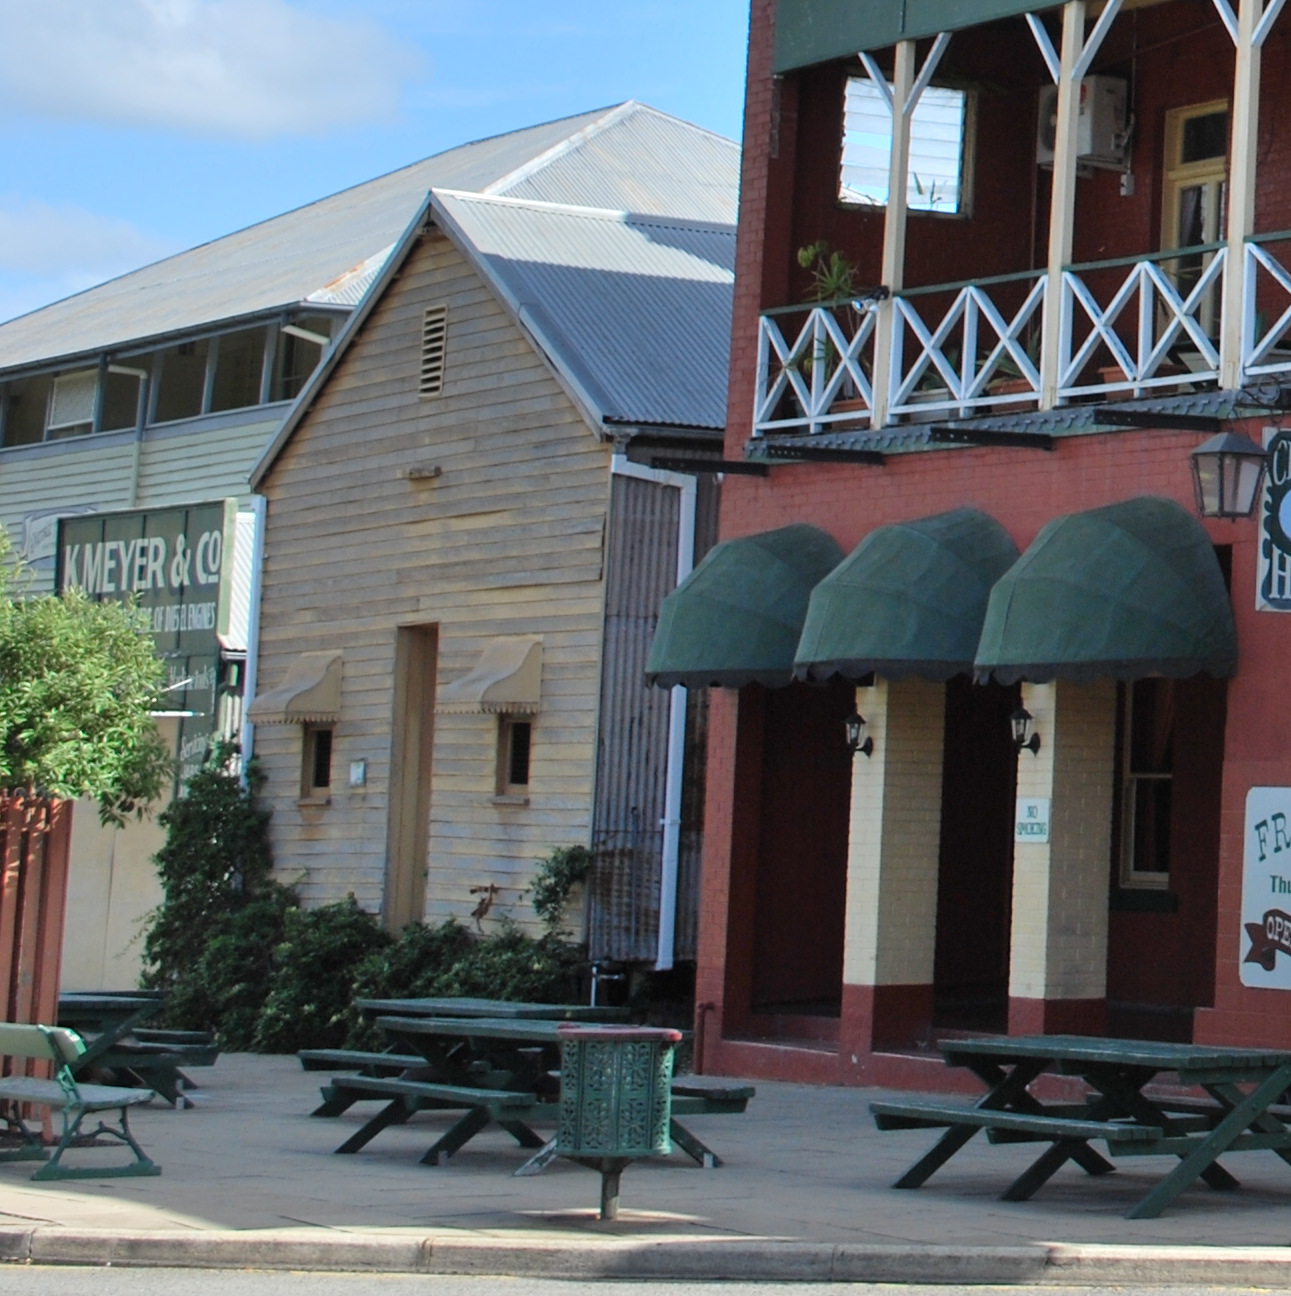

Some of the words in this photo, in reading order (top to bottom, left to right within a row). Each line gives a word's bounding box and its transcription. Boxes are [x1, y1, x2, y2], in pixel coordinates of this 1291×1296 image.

[82, 536, 168, 594] MEYER
[170, 533, 191, 589] &
[1027, 805, 1039, 819] NO
